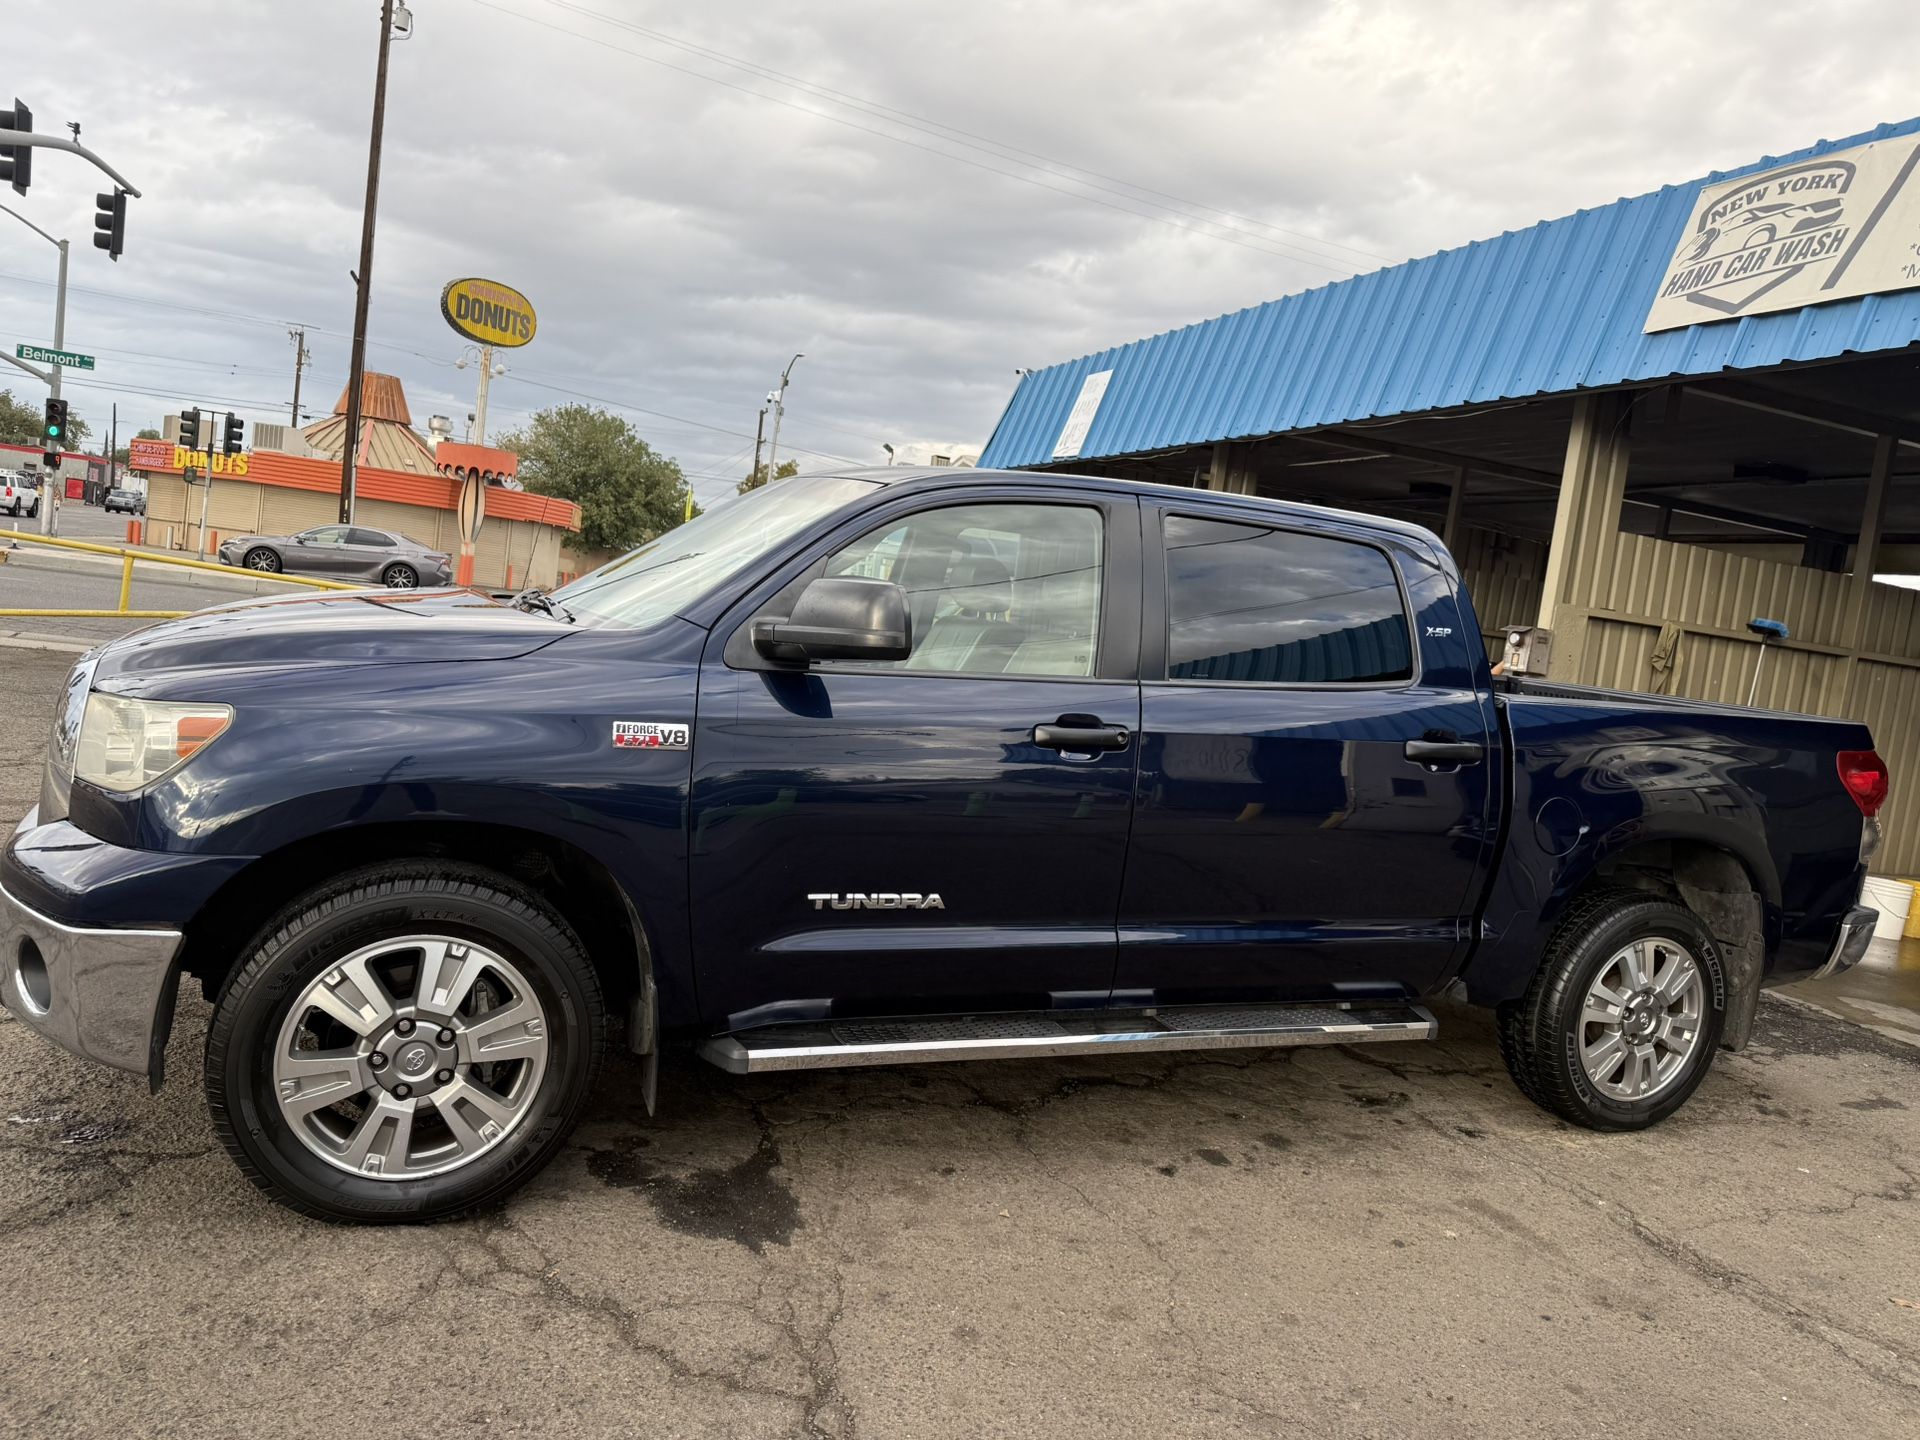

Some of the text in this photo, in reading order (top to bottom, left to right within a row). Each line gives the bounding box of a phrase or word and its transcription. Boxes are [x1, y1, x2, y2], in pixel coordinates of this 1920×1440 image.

[1710, 173, 1845, 225] NEW YORK
[1661, 227, 1850, 298] HAND CAR WASH
[456, 293, 531, 339] DONUTS
[22, 346, 81, 367] Belmont
[173, 447, 248, 476] DONUTS
[660, 730, 687, 745] V8
[807, 893, 946, 910] TUNDRA
[1704, 947, 1723, 1007] MICHELIN
